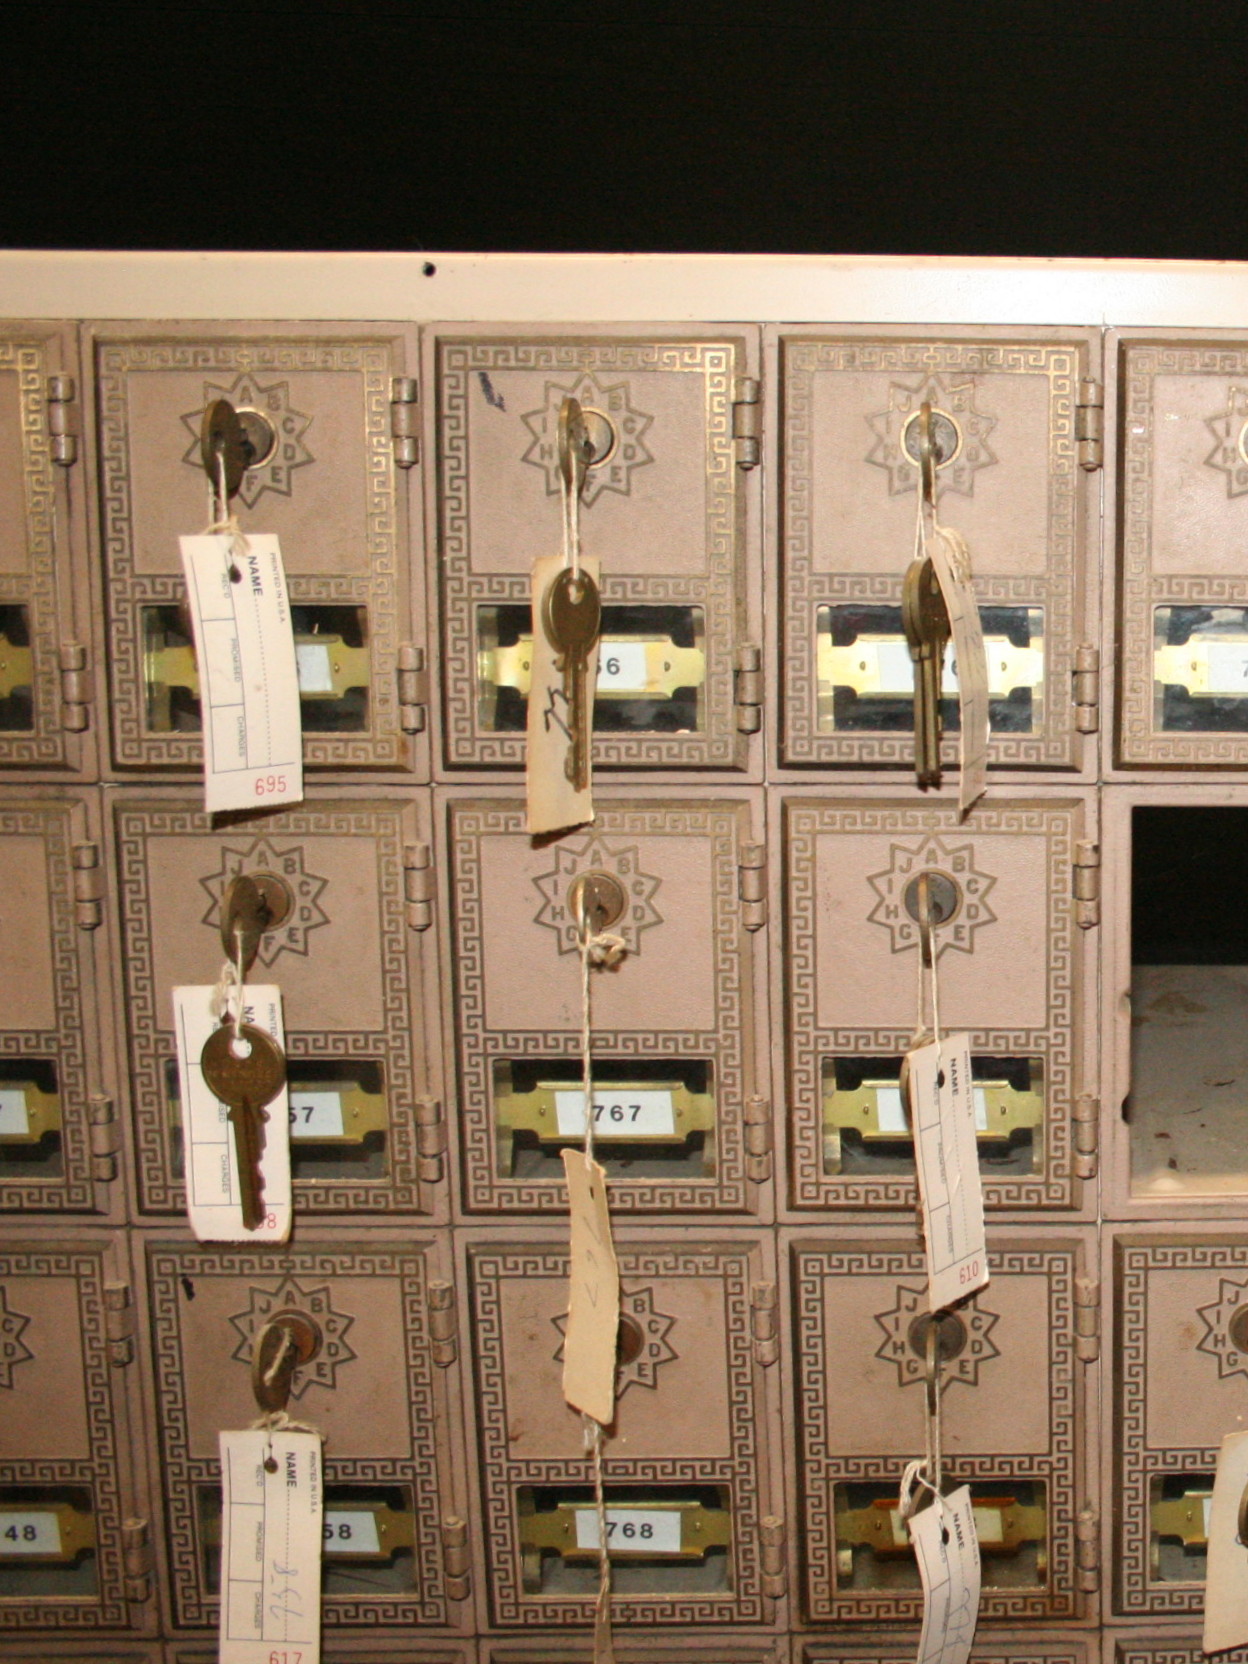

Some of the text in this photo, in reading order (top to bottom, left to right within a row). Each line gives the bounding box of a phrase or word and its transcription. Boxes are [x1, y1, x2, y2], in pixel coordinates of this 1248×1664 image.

[582, 385, 594, 403] A
[609, 392, 621, 411] B
[623, 416, 636, 434] C
[240, 385, 296, 492] A B C D E F
[540, 444, 553, 460] H
[623, 443, 636, 460] D
[611, 466, 622, 482] E
[247, 555, 263, 597] NAME
[255, 775, 287, 796] 695
[258, 851, 269, 866] A
[591, 849, 603, 866] A
[926, 848, 937, 864] A
[952, 856, 965, 872] B
[284, 858, 296, 874] B
[564, 859, 577, 875] J
[618, 857, 630, 874] B
[899, 858, 912, 873] J
[299, 881, 311, 896] C
[632, 881, 644, 896] C
[966, 878, 979, 894] C
[301, 906, 312, 921] D
[551, 906, 564, 920] H
[633, 905, 645, 920] D
[885, 904, 898, 919] H
[966, 904, 979, 919] D
[288, 927, 299, 943] E
[899, 924, 911, 939] G
[954, 925, 965, 941] E
[264, 936, 275, 952] F
[244, 1006, 255, 1024] NA
[950, 1058, 959, 1096] NAME
[288, 1106, 314, 1124] 57
[591, 1104, 642, 1122] 767
[221, 1154, 230, 1193] CHARGES
[960, 1260, 979, 1285] 610
[285, 1290, 296, 1305] A
[311, 1297, 323, 1312] B
[905, 1297, 918, 1312] J
[1227, 1290, 1239, 1305] J
[259, 1300, 271, 1314] J
[326, 1319, 337, 1332] C
[971, 1317, 982, 1330] C
[3, 1319, 15, 1356] C D
[634, 1299, 660, 1377] B C D E
[1214, 1334, 1226, 1348] H
[328, 1343, 339, 1356] D
[893, 1341, 905, 1355] H
[972, 1340, 982, 1354] D
[907, 1359, 918, 1374] G
[1227, 1351, 1238, 1366] G
[316, 1362, 327, 1377] E
[960, 1360, 970, 1374] E
[286, 1451, 297, 1488] NAME
[5, 1525, 37, 1542] 48
[323, 1523, 352, 1540] 58
[604, 1521, 654, 1539] 768
[953, 1513, 964, 1550] NAME
[269, 1650, 302, 1664] 617
